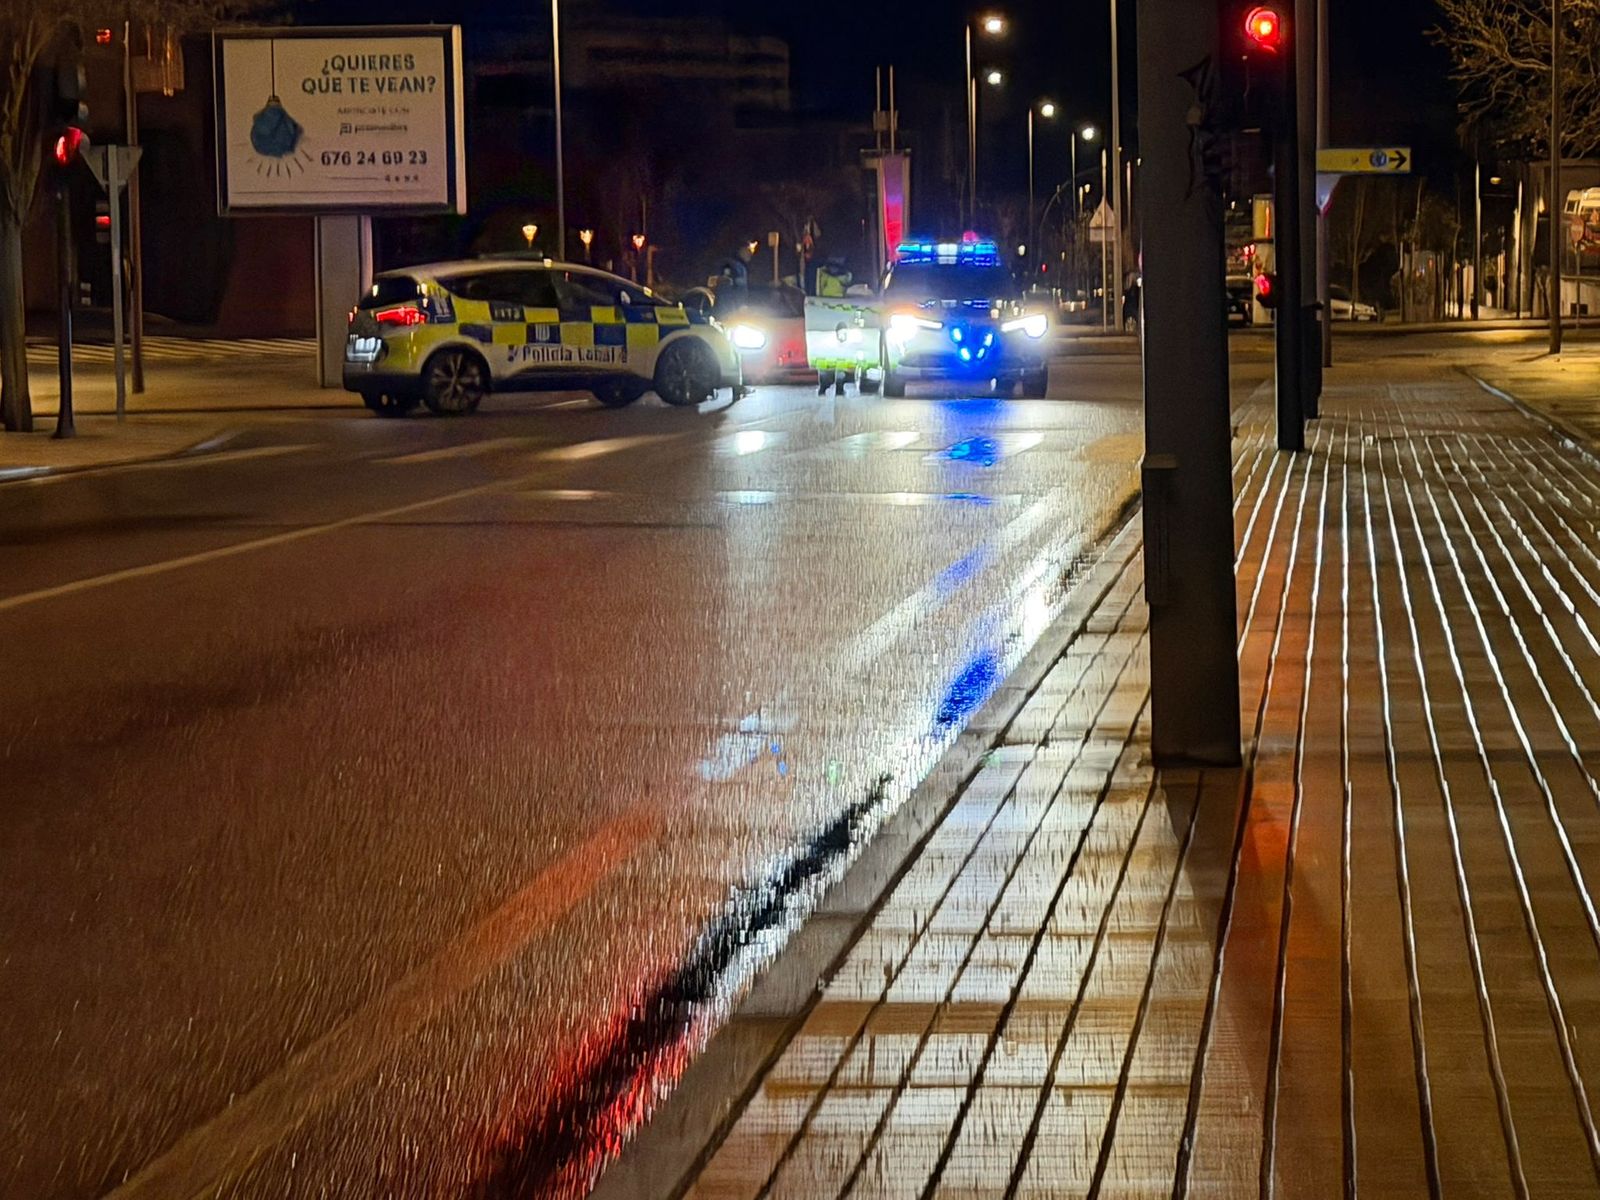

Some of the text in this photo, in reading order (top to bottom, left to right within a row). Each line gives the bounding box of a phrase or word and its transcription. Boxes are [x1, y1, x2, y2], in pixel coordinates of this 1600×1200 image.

[321, 53, 416, 75] ¿QUIERES
[301, 75, 436, 94] QUE TE VEAN?
[320, 150, 352, 166] 676
[356, 150, 376, 165] 24
